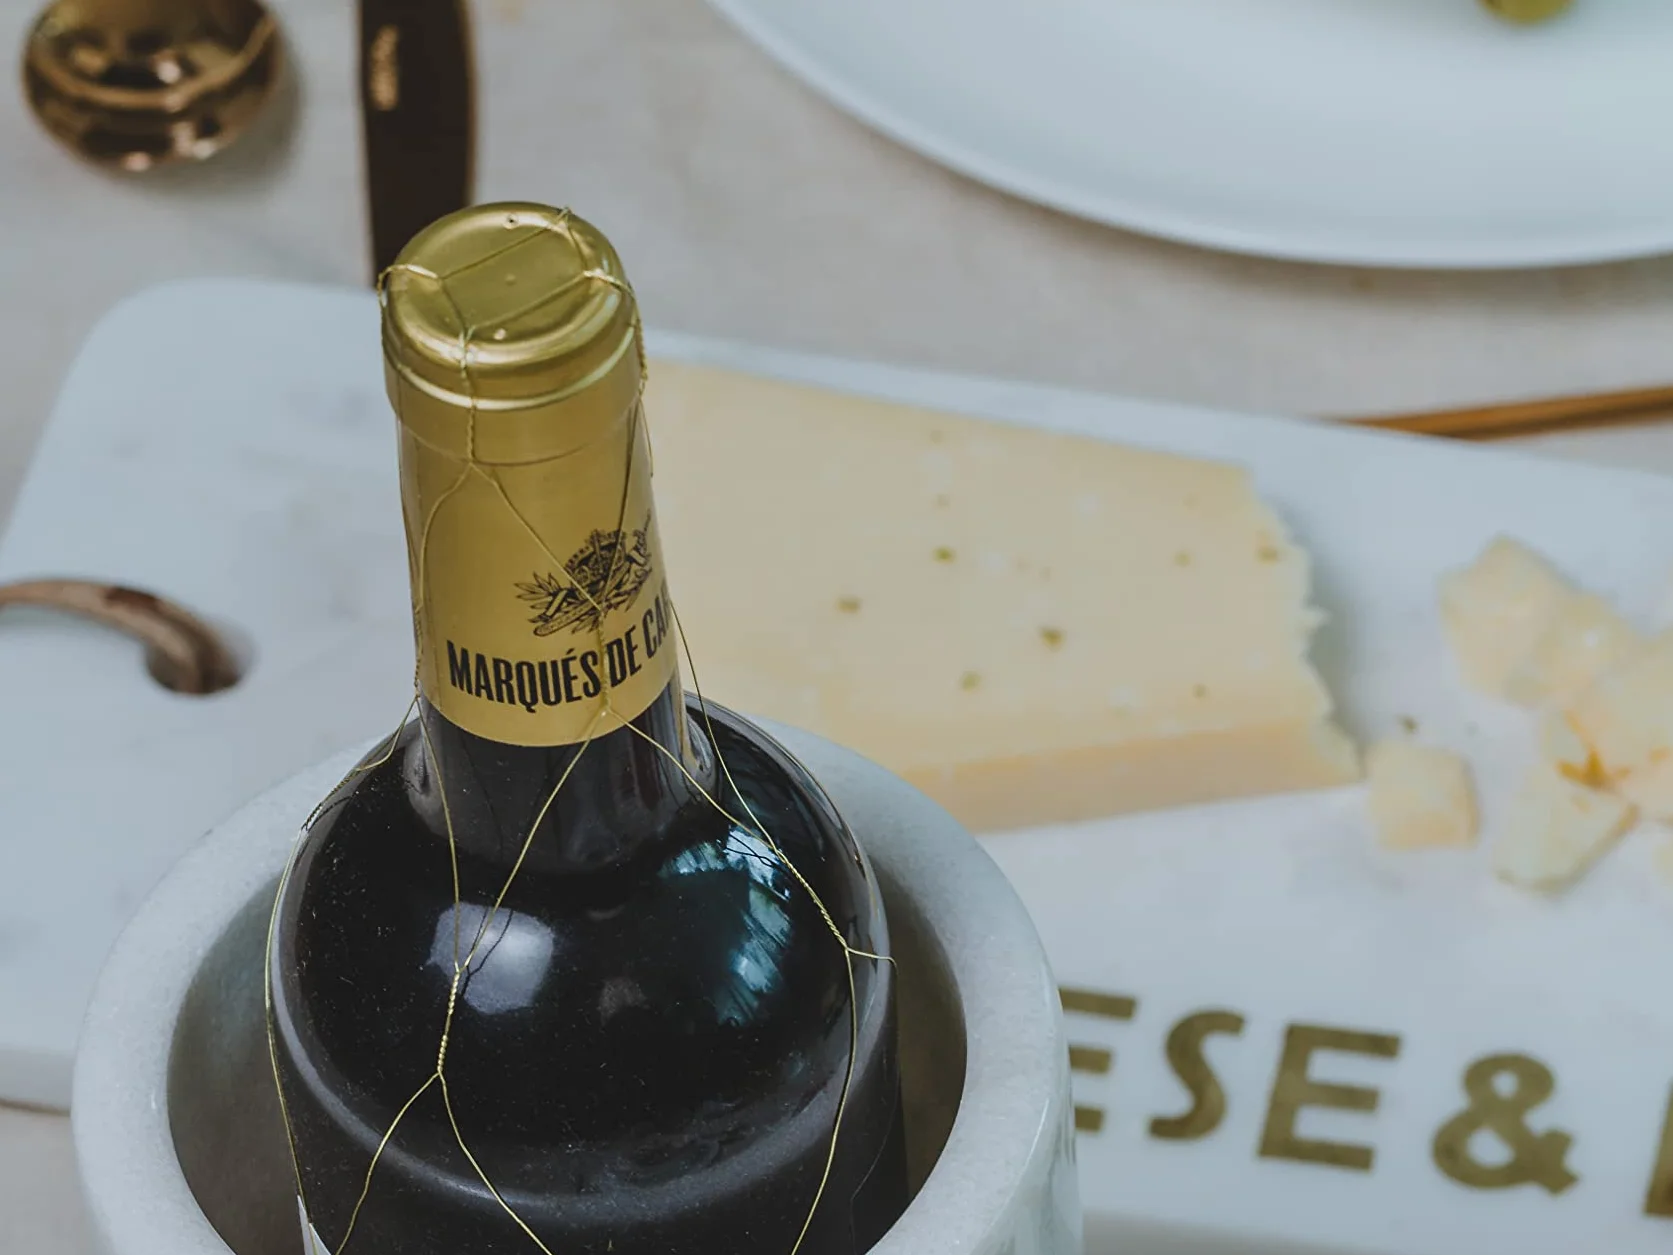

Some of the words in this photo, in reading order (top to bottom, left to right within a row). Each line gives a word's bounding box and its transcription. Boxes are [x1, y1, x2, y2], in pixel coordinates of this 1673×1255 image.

[446, 639, 601, 714] MARQUÉS
[606, 624, 643, 688] DE
[1432, 1051, 1581, 1197] &
